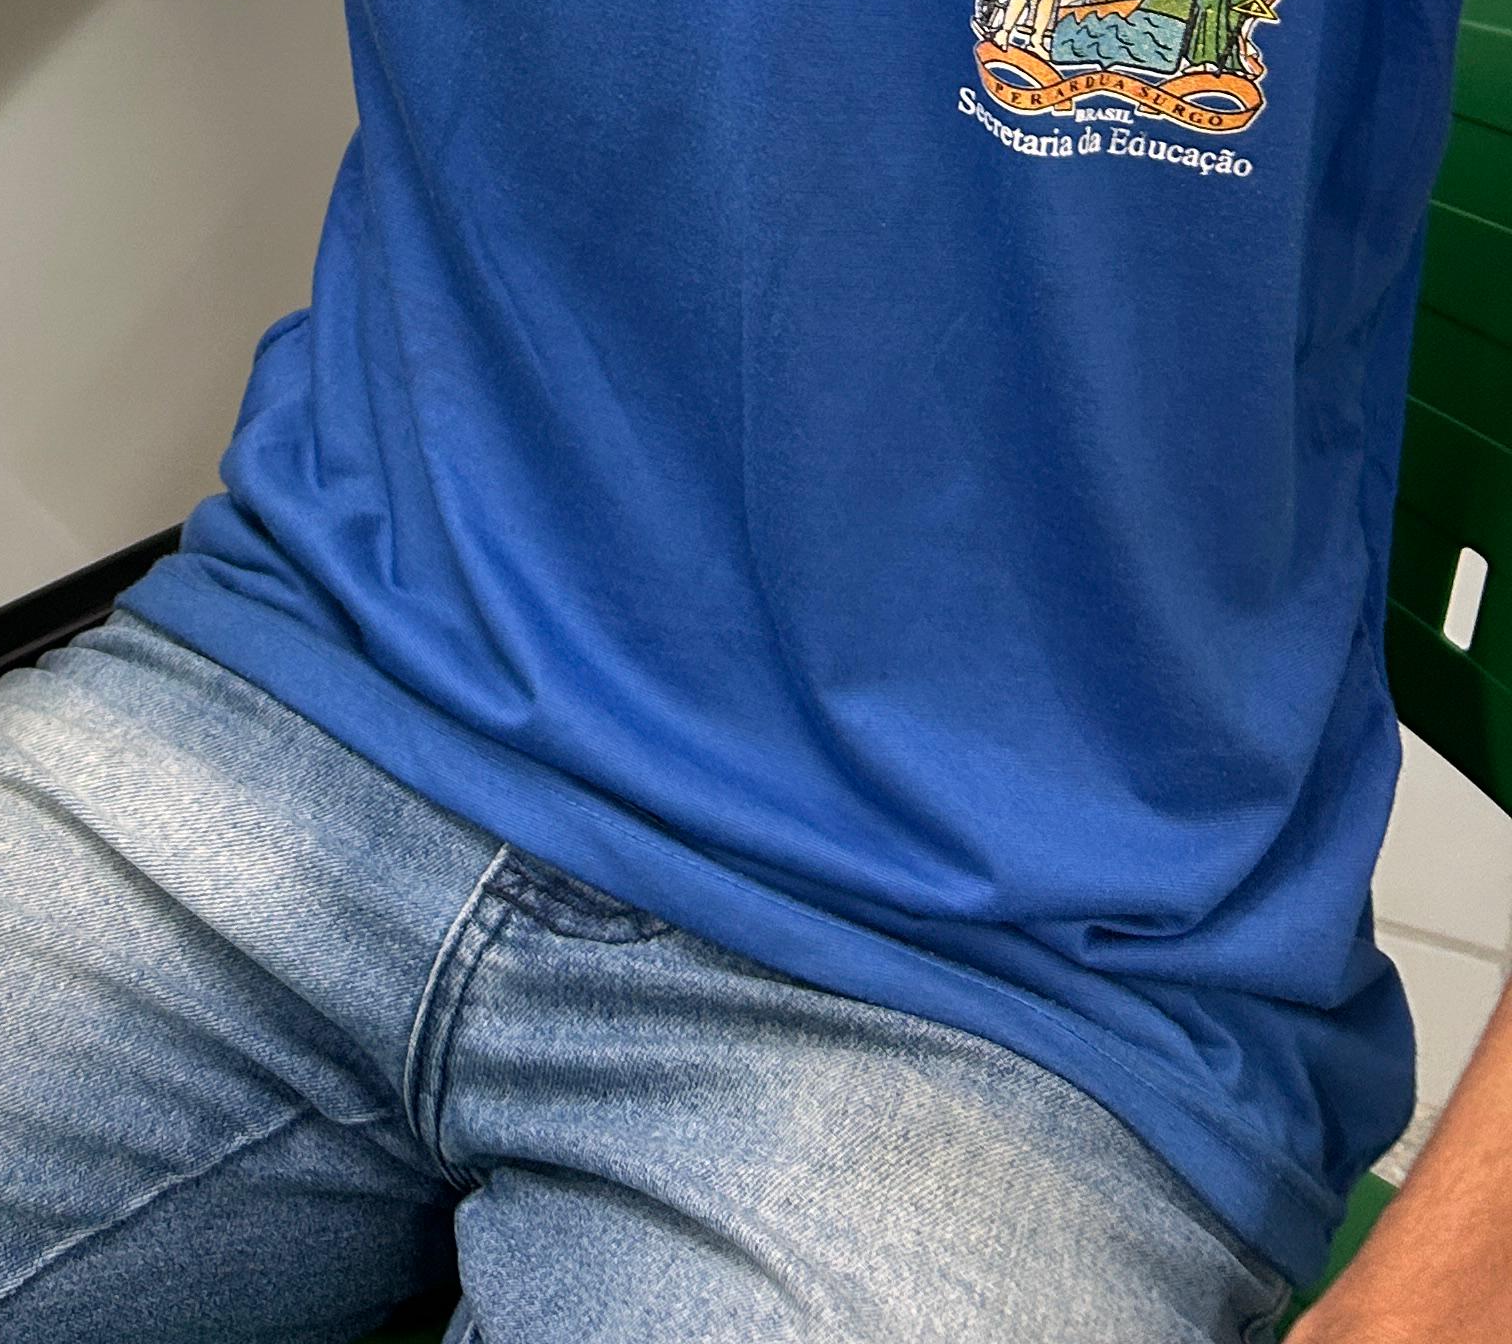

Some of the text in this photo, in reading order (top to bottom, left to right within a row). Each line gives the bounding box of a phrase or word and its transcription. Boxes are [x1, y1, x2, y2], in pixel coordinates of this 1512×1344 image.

[994, 75, 1225, 128] PER ARDUA SURGO
[1074, 107, 1135, 125] BRASIL
[958, 87, 1254, 177] Secretaria da Educação
